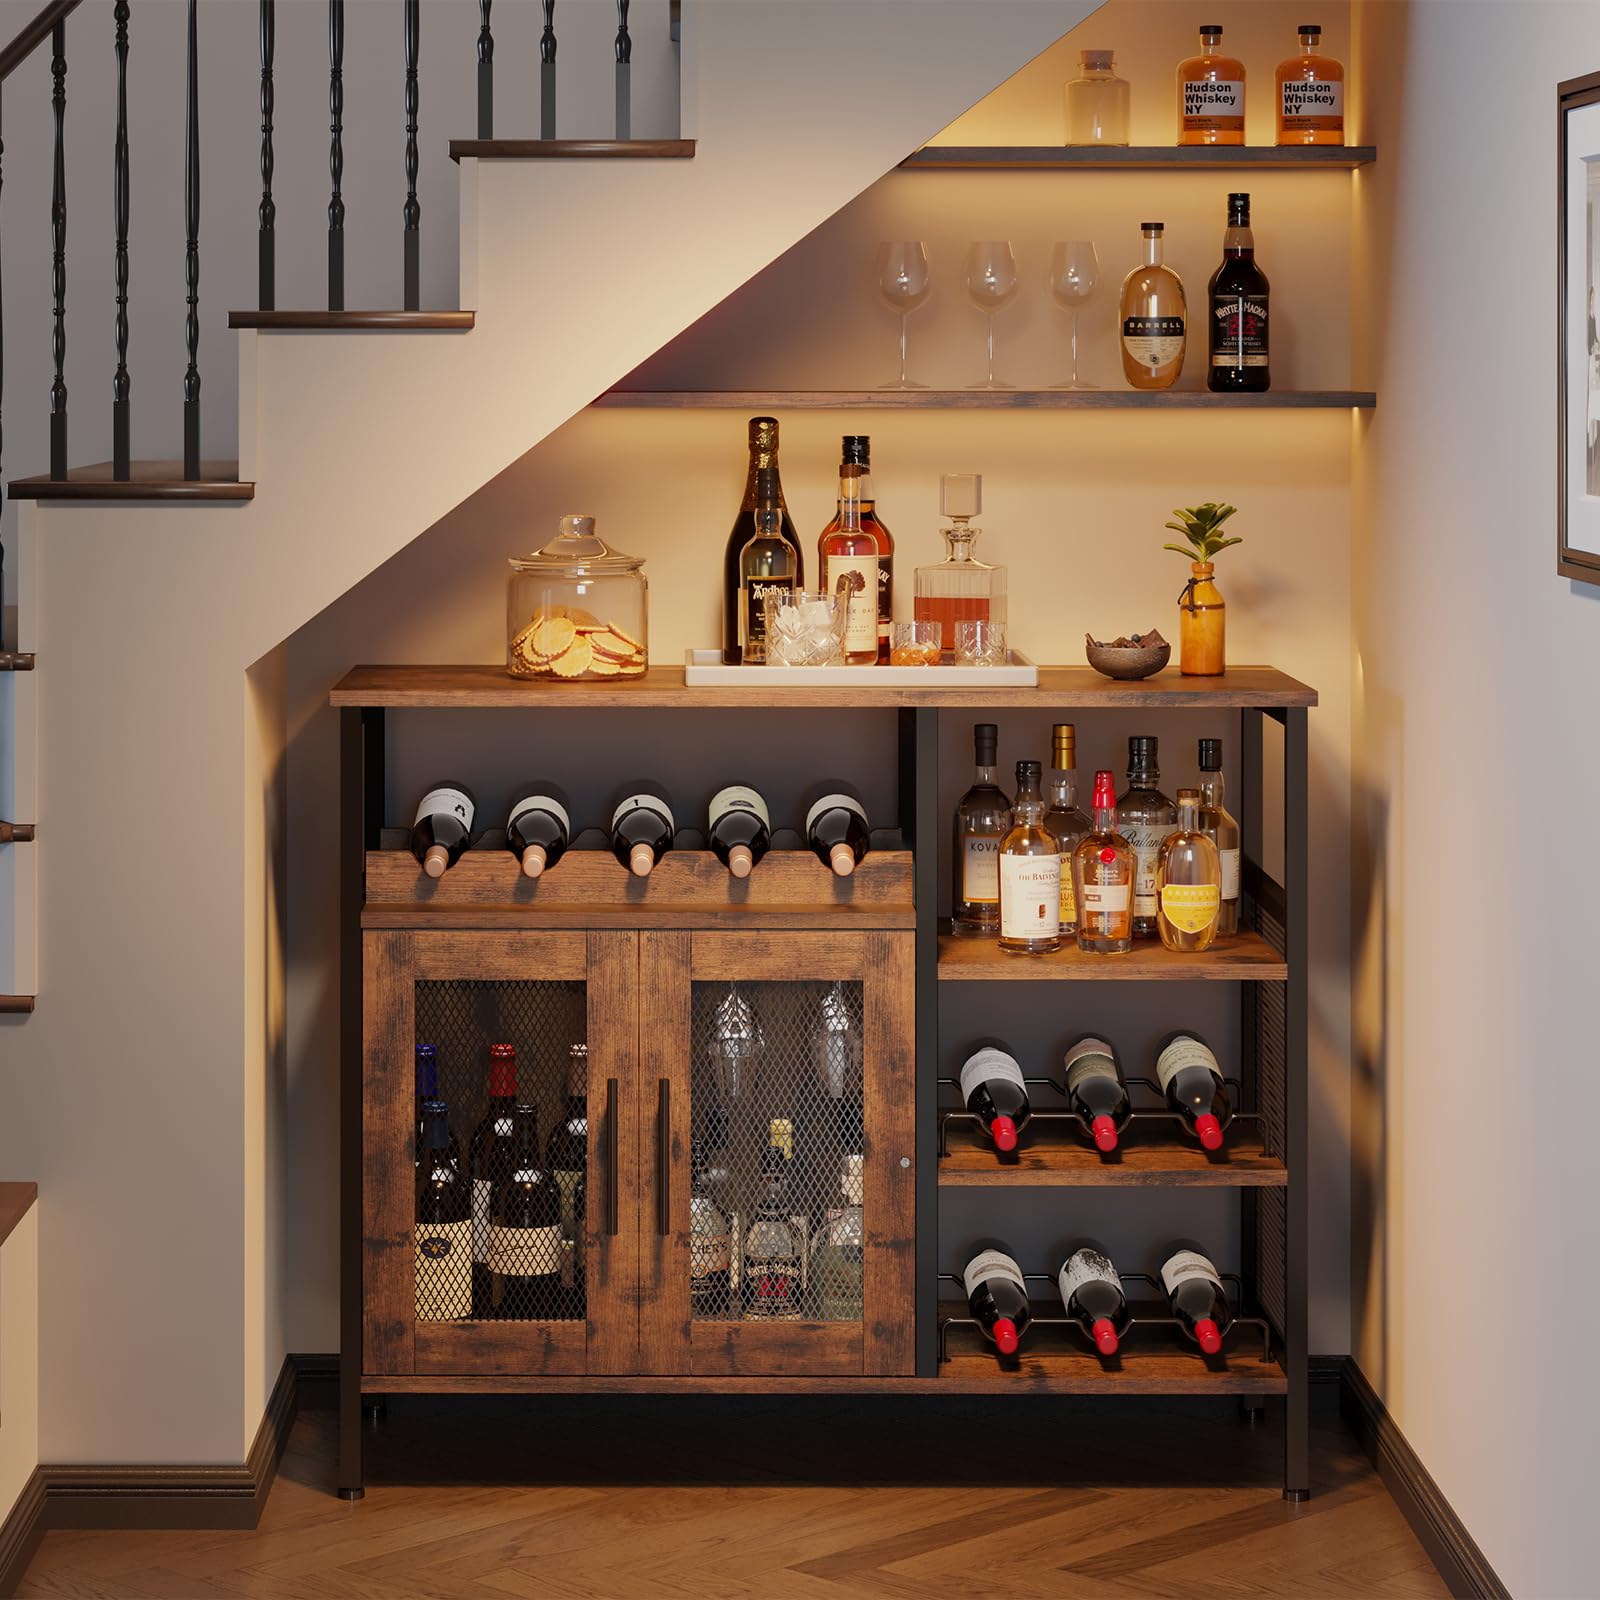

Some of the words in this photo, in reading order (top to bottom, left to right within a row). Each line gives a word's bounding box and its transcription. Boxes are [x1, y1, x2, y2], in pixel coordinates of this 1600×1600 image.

[1185, 82, 1231, 93] Hudson
[1284, 82, 1331, 93] Hudson
[1185, 93, 1236, 106] Whiskey
[1284, 93, 1336, 106] Whiskey
[1185, 104, 1203, 115] NY
[1284, 104, 1302, 115] NY
[1215, 303, 1239, 319] WHYTE
